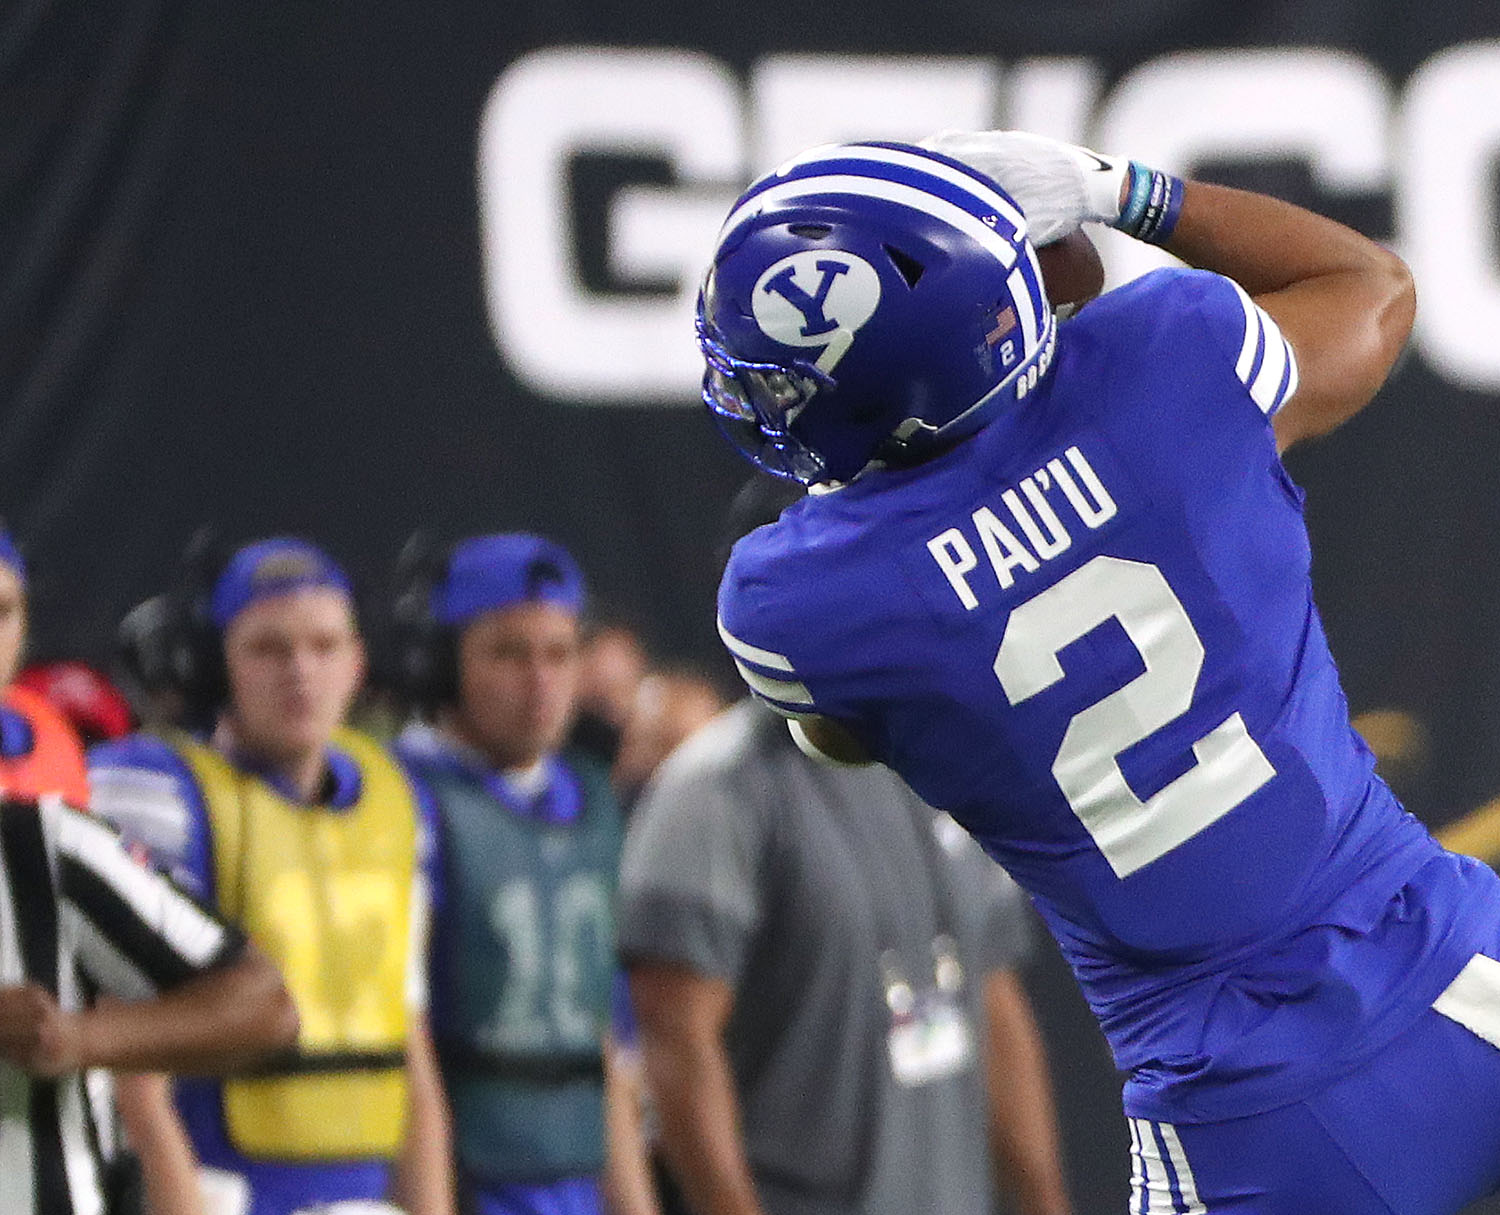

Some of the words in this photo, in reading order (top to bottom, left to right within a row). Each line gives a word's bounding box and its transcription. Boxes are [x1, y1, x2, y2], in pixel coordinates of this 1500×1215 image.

[763, 260, 851, 337] Y
[1000, 339, 1015, 367] 2
[926, 446, 1118, 611] PAU'U
[993, 555, 1277, 880] 2
